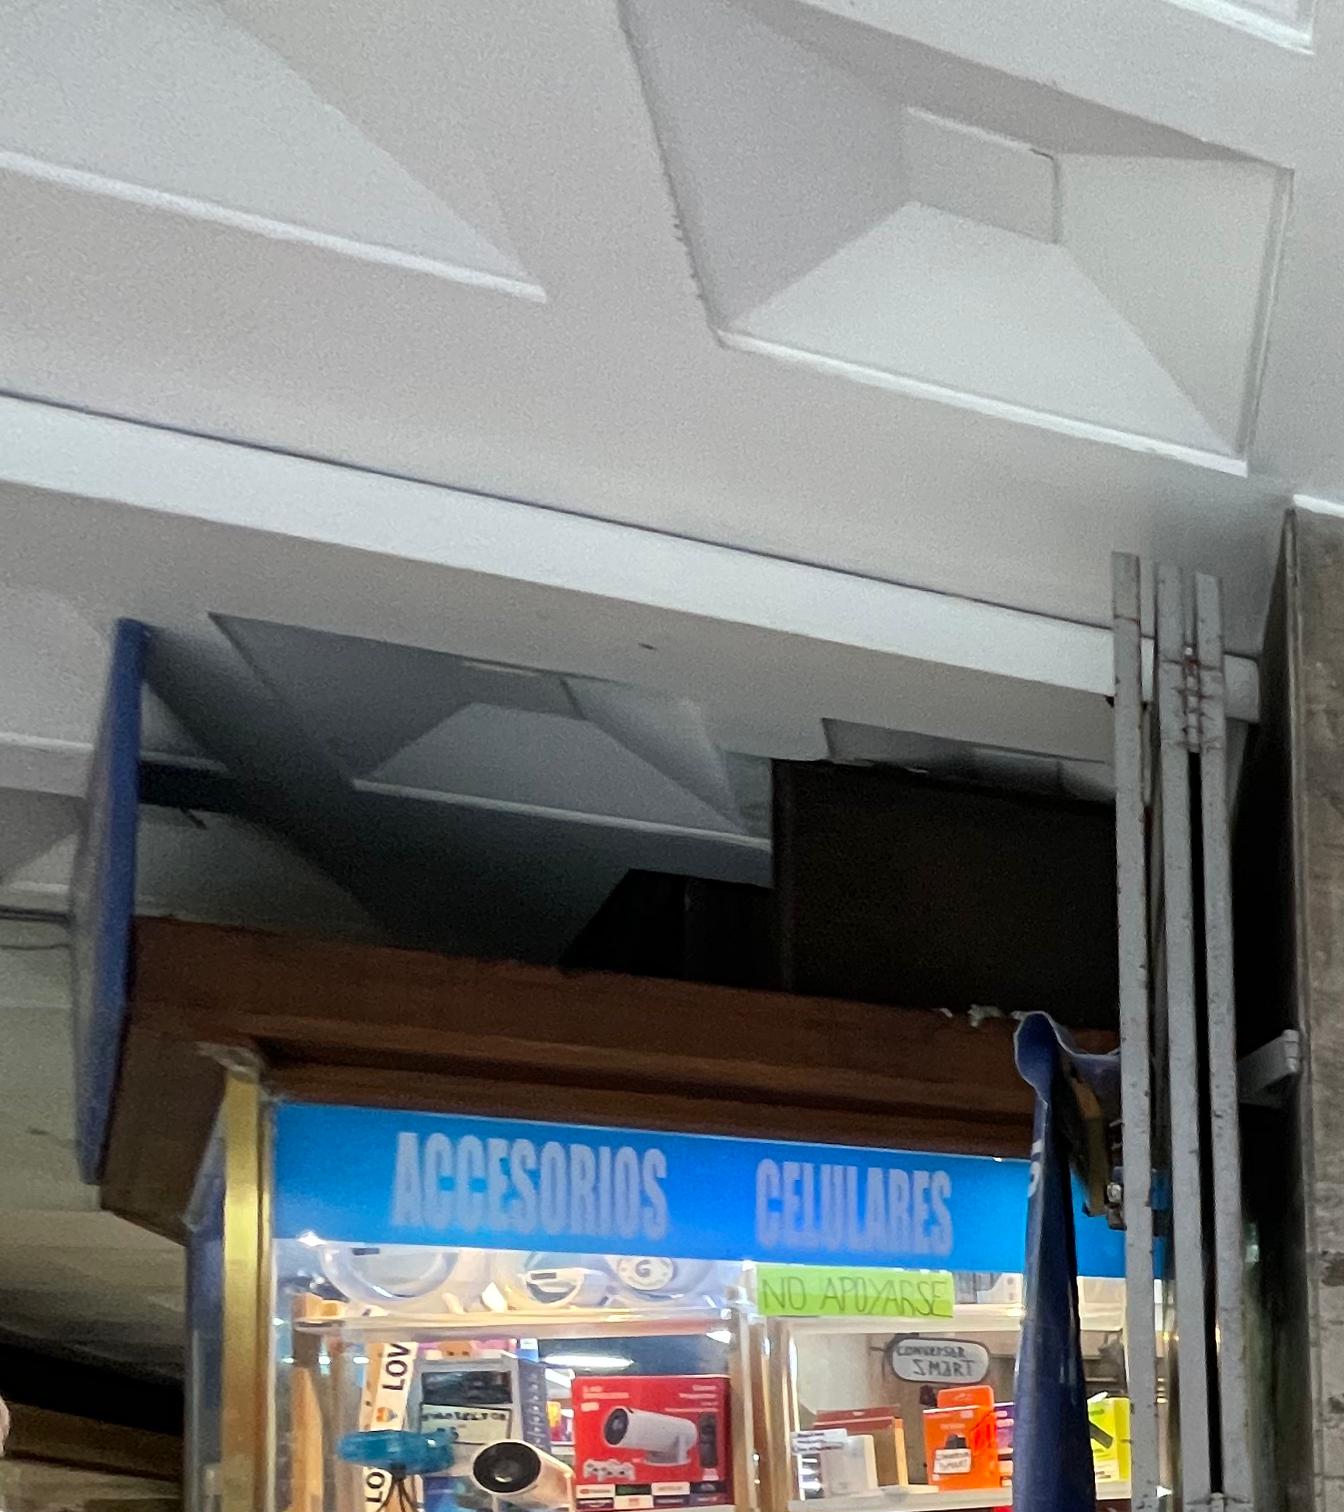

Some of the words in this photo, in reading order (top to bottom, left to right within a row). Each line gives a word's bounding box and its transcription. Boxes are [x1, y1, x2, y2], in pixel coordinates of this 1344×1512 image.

[391, 1132, 669, 1241] ACCESORIOS
[755, 1158, 953, 1256] CELULARES
[762, 1276, 805, 1311] NO
[820, 1276, 953, 1318] APOYARSE
[912, 1358, 975, 1377] SMART
[366, 1472, 386, 1504] LO
